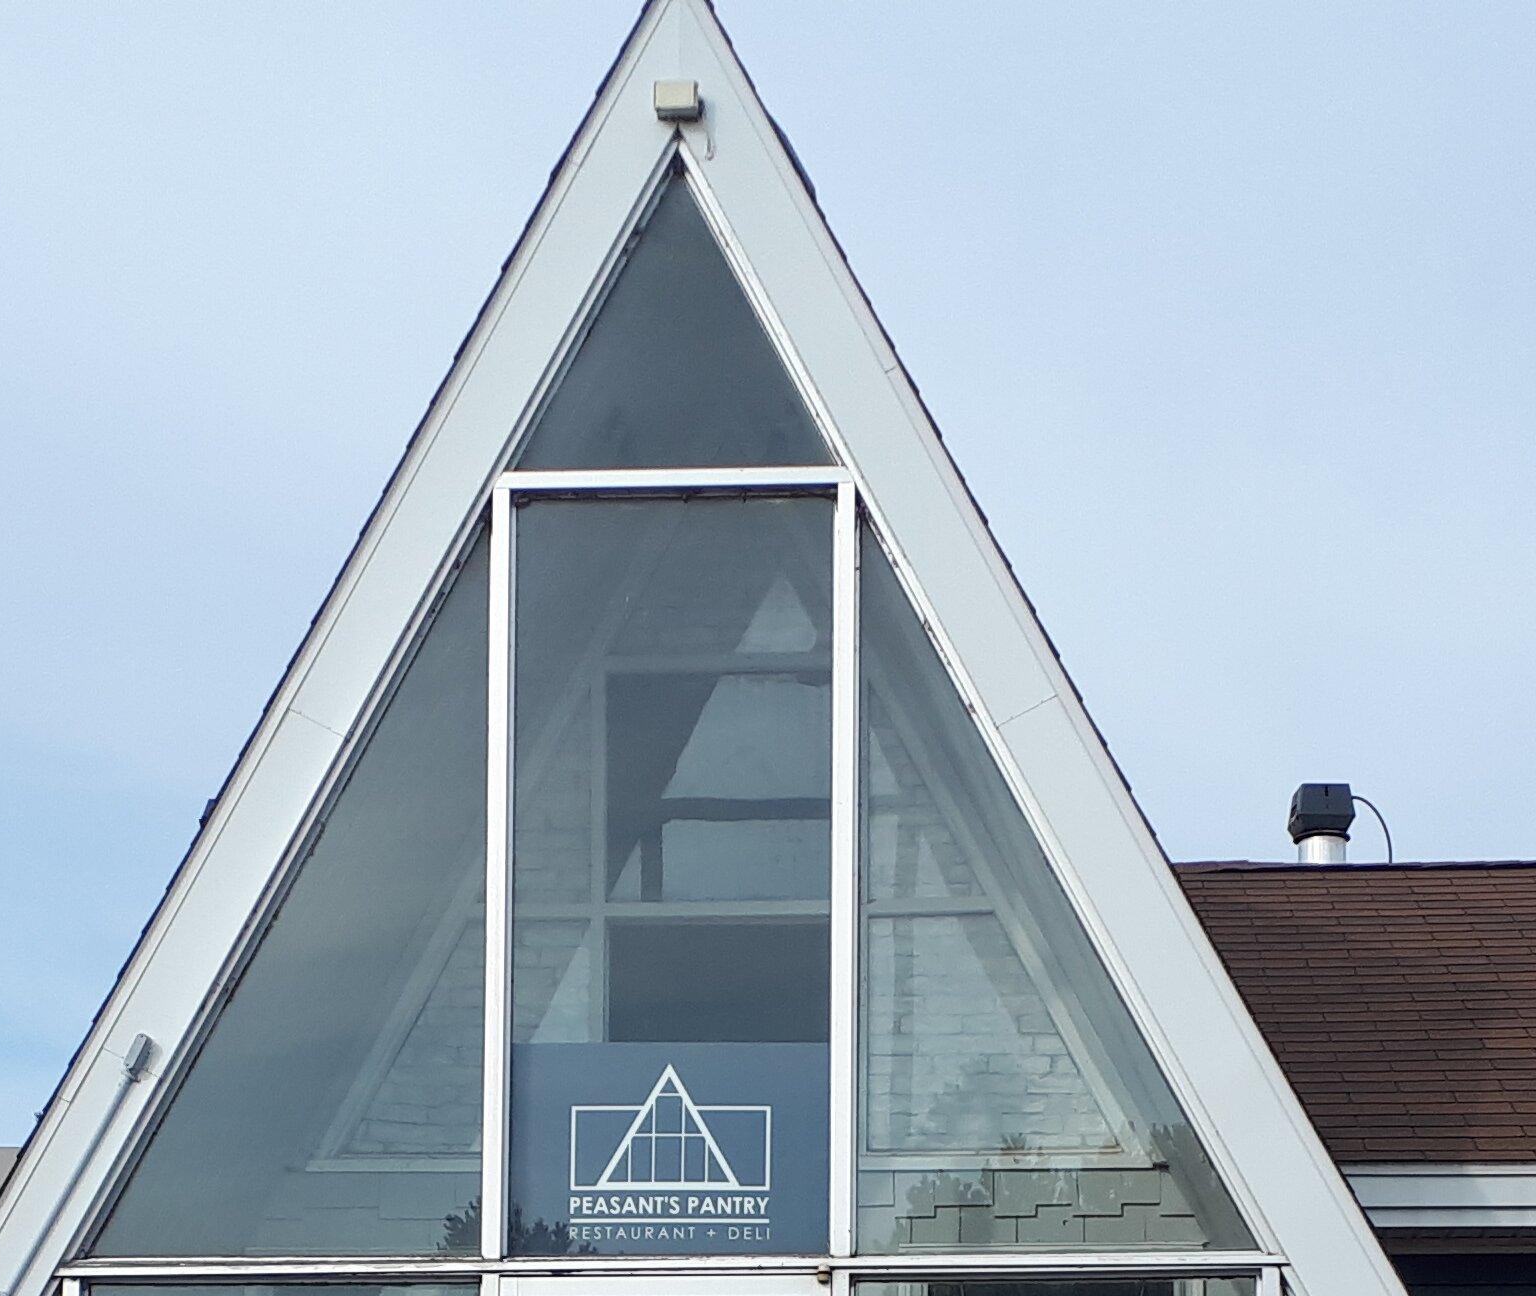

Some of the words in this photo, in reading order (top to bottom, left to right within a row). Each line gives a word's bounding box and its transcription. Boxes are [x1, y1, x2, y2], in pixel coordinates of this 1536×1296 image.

[569, 1196, 680, 1215] PEASANT'S
[687, 1196, 770, 1215] PANTRY
[568, 1226, 696, 1240] RESTAURANT
[728, 1226, 771, 1240] DELI
